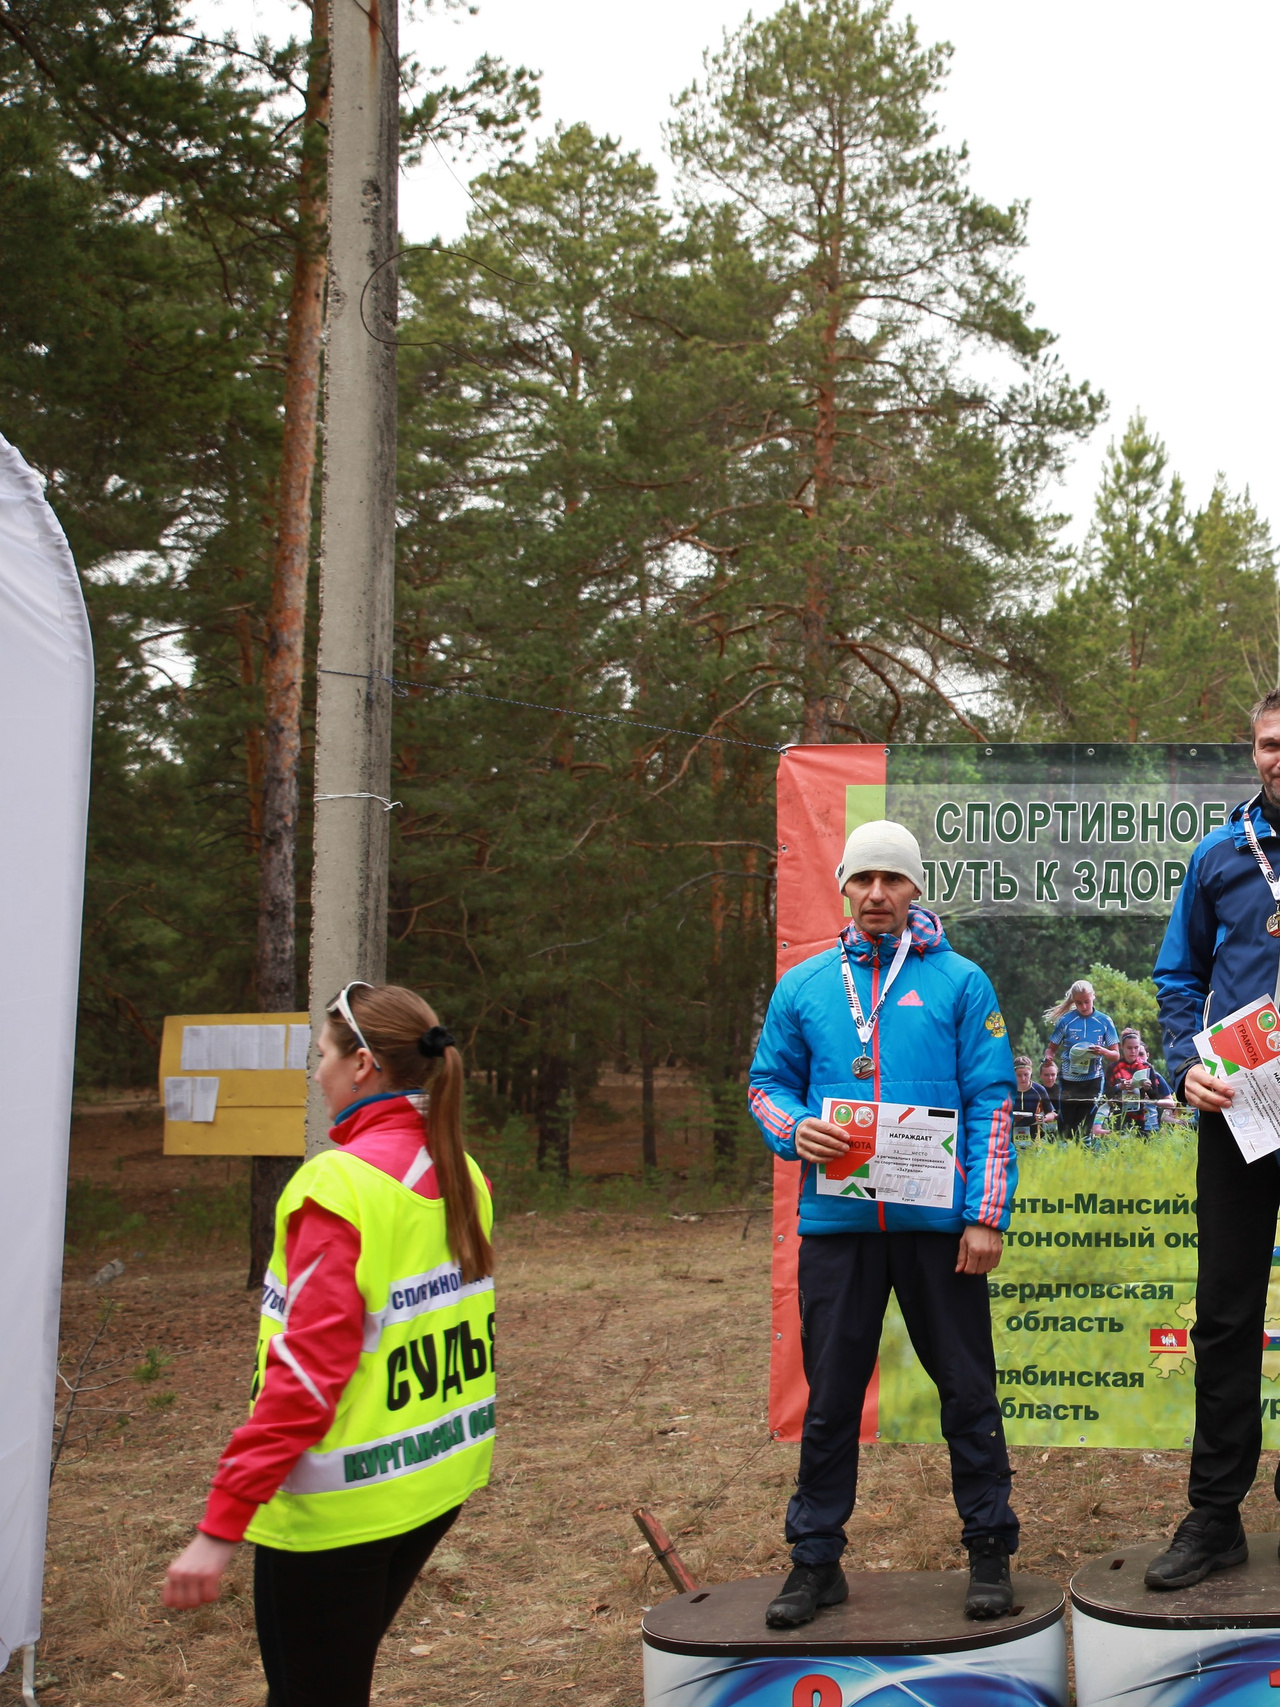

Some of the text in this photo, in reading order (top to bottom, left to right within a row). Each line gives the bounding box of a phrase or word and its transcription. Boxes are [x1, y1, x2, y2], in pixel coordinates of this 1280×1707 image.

[935, 802, 1226, 844] СПОРТИВНОЕ
[1036, 861, 1059, 902] К
[1073, 860, 1186, 909] ЗДОР
[1237, 1023, 1259, 1065] ГРАМОТА
[847, 1140, 872, 1150] МОТА
[889, 1132, 932, 1142] НАГРАЖДАЕТ
[1011, 1193, 1197, 1215] нты-Мансий
[1001, 1226, 1198, 1248] тономный ок
[988, 1282, 1173, 1303] вердловская
[1006, 1311, 1124, 1332] область
[996, 1365, 1144, 1388] лябинская
[1001, 1397, 1099, 1420] бласть
